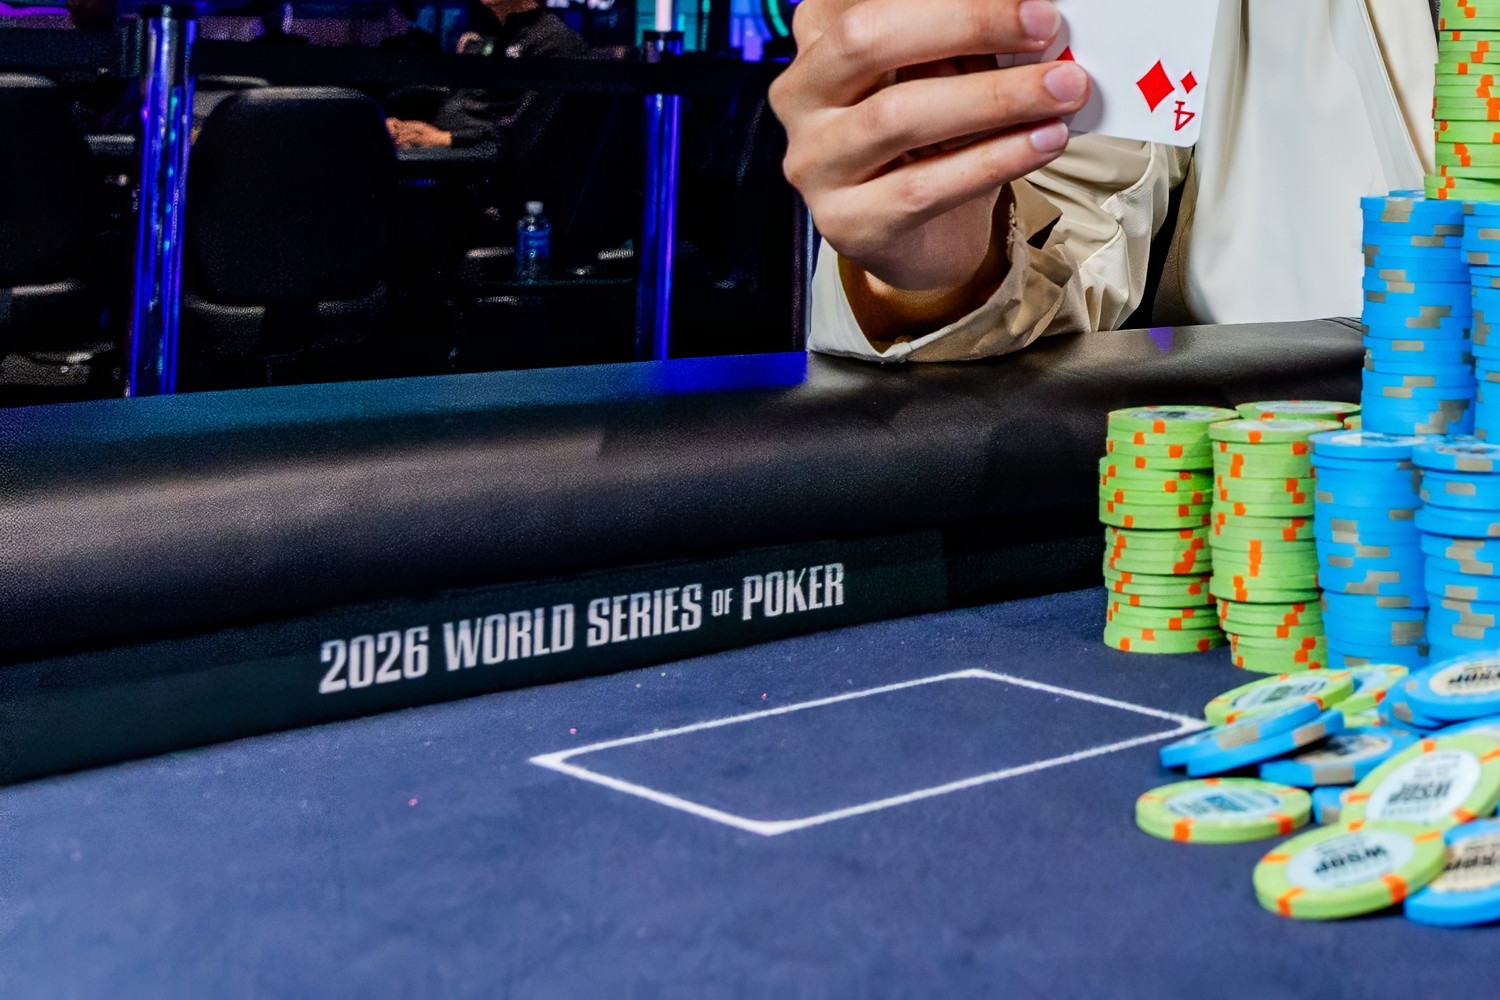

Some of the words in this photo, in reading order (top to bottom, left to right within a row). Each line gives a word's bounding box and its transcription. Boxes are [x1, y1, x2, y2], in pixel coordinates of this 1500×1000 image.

[1173, 100, 1196, 132] 4
[319, 625, 430, 694] 2026
[443, 603, 575, 672] WORLD
[587, 583, 703, 648] SERIES
[711, 587, 734, 617] OF
[742, 562, 845, 621] POKER
